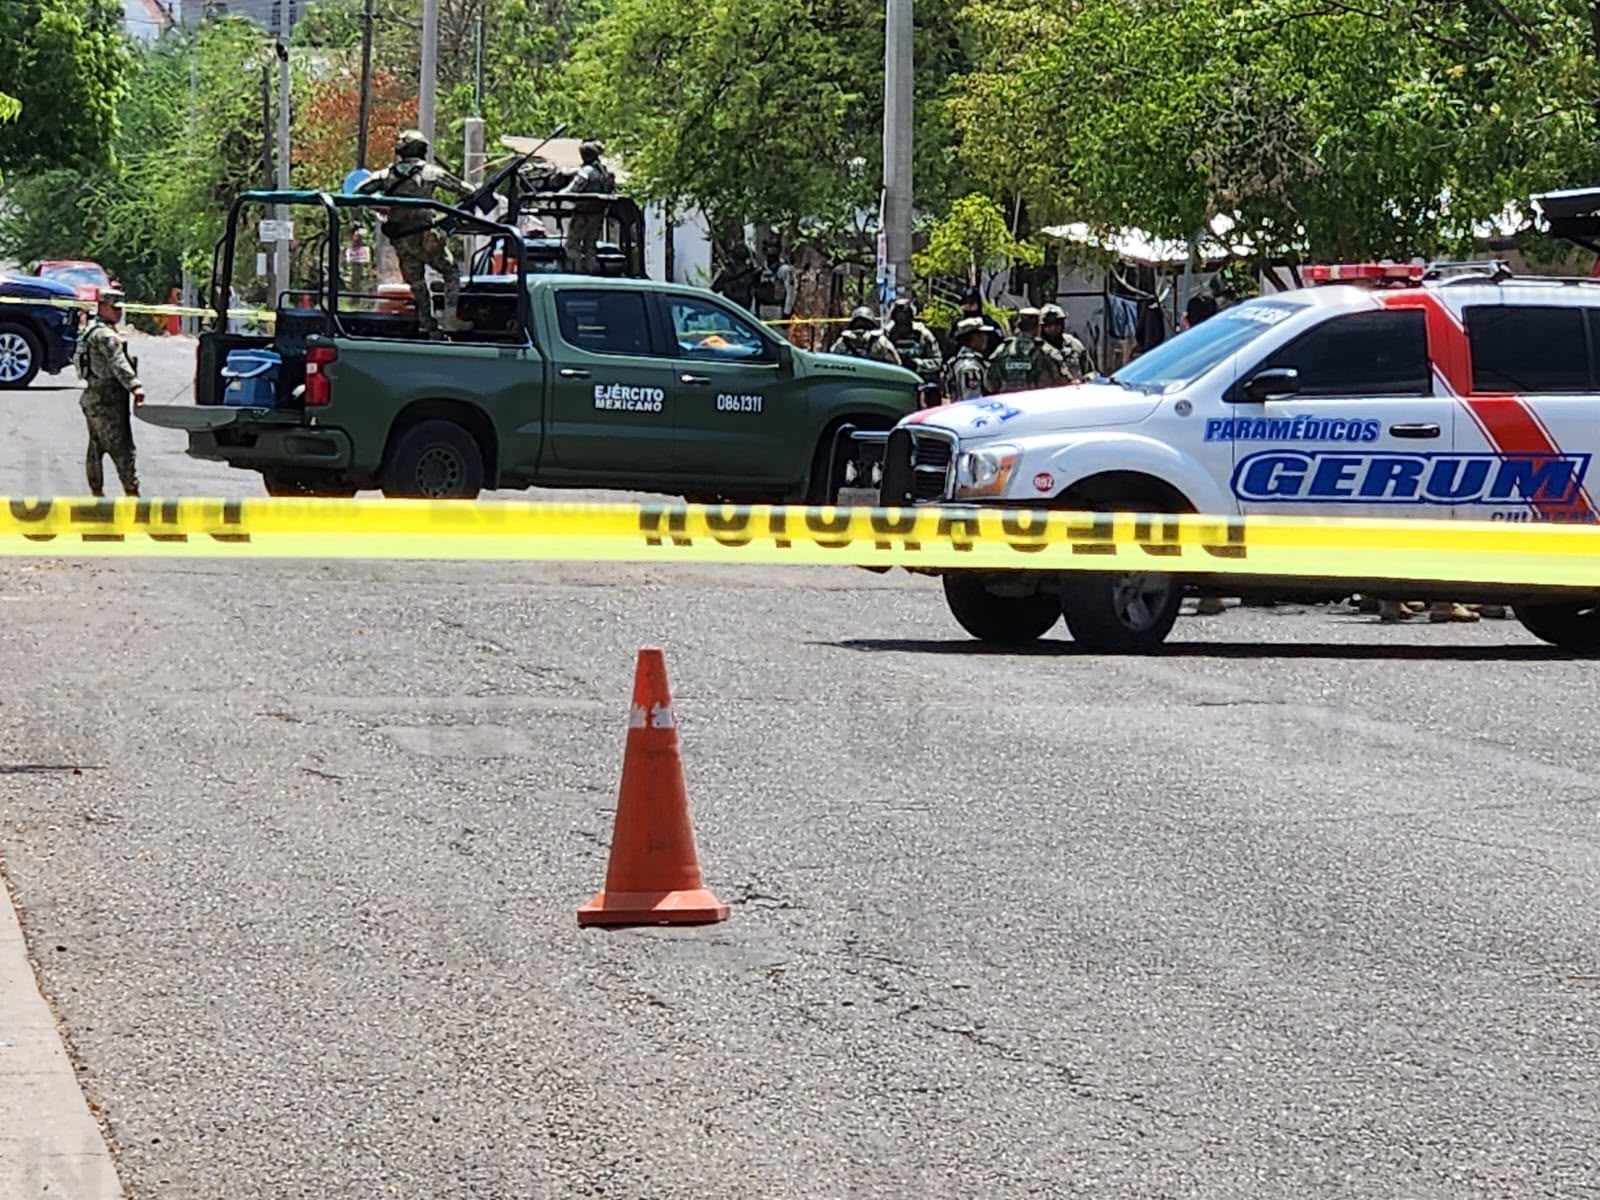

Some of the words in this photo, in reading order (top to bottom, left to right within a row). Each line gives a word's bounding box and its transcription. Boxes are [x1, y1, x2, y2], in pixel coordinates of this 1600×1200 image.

[594, 383, 665, 402] EJÉRCITO
[594, 398, 662, 412] MEXICANO
[717, 393, 763, 412] 0861311
[1205, 414, 1380, 441] PARAMÉDICOS
[1236, 453, 1584, 502] GERUM
